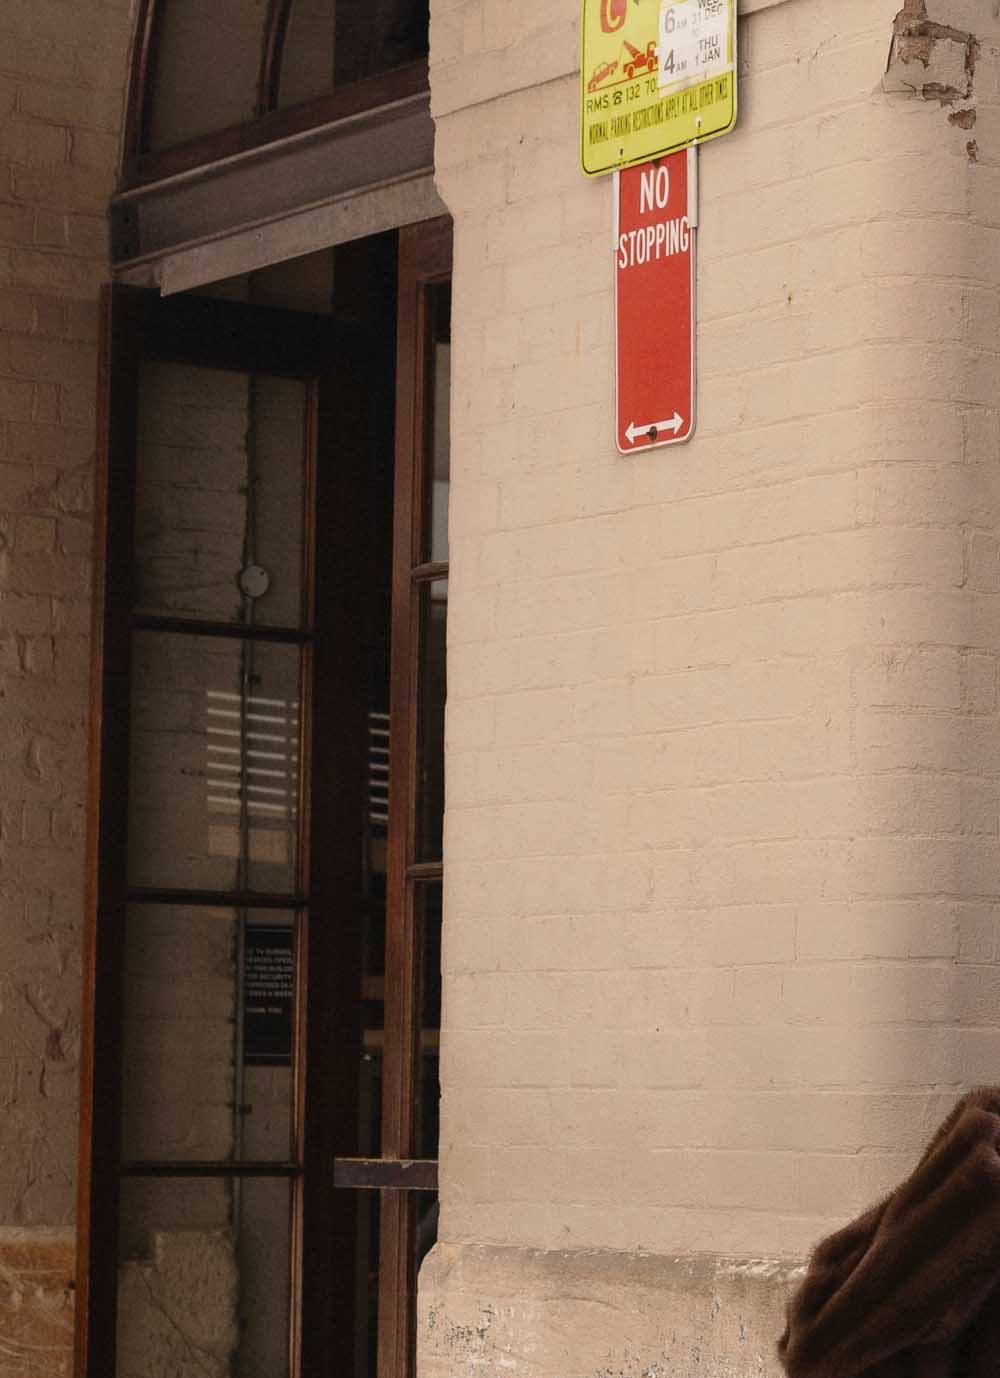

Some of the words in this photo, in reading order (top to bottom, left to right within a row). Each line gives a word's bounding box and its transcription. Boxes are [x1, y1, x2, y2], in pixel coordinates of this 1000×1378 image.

[664, 8, 675, 33] 6
[699, 34, 719, 51] THU
[664, 49, 676, 74] 4
[702, 48, 721, 63] JAN
[587, 94, 609, 115] RMS
[626, 84, 641, 102] 132
[645, 78, 657, 96] 70
[665, 97, 680, 120] APPLY
[640, 165, 669, 214] NO
[618, 216, 689, 270] STOPPING
